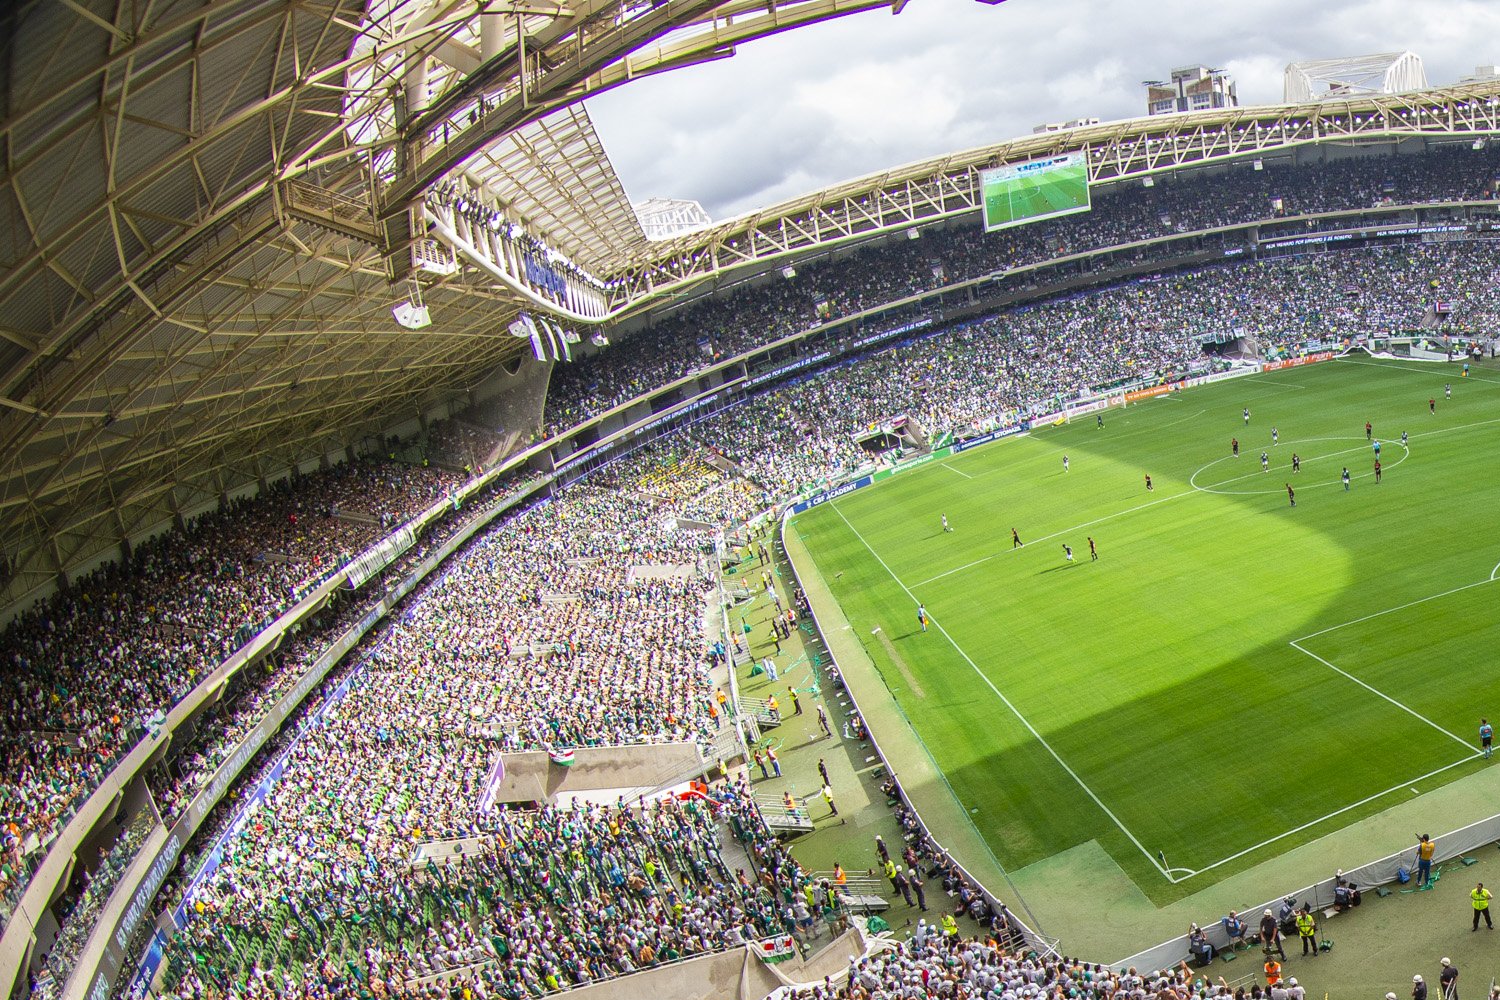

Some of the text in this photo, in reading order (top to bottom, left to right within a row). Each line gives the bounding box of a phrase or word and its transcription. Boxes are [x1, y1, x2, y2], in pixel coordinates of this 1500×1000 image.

[890, 454, 934, 475] globoesporte.com
[812, 482, 858, 506] CBF ACADEMY
